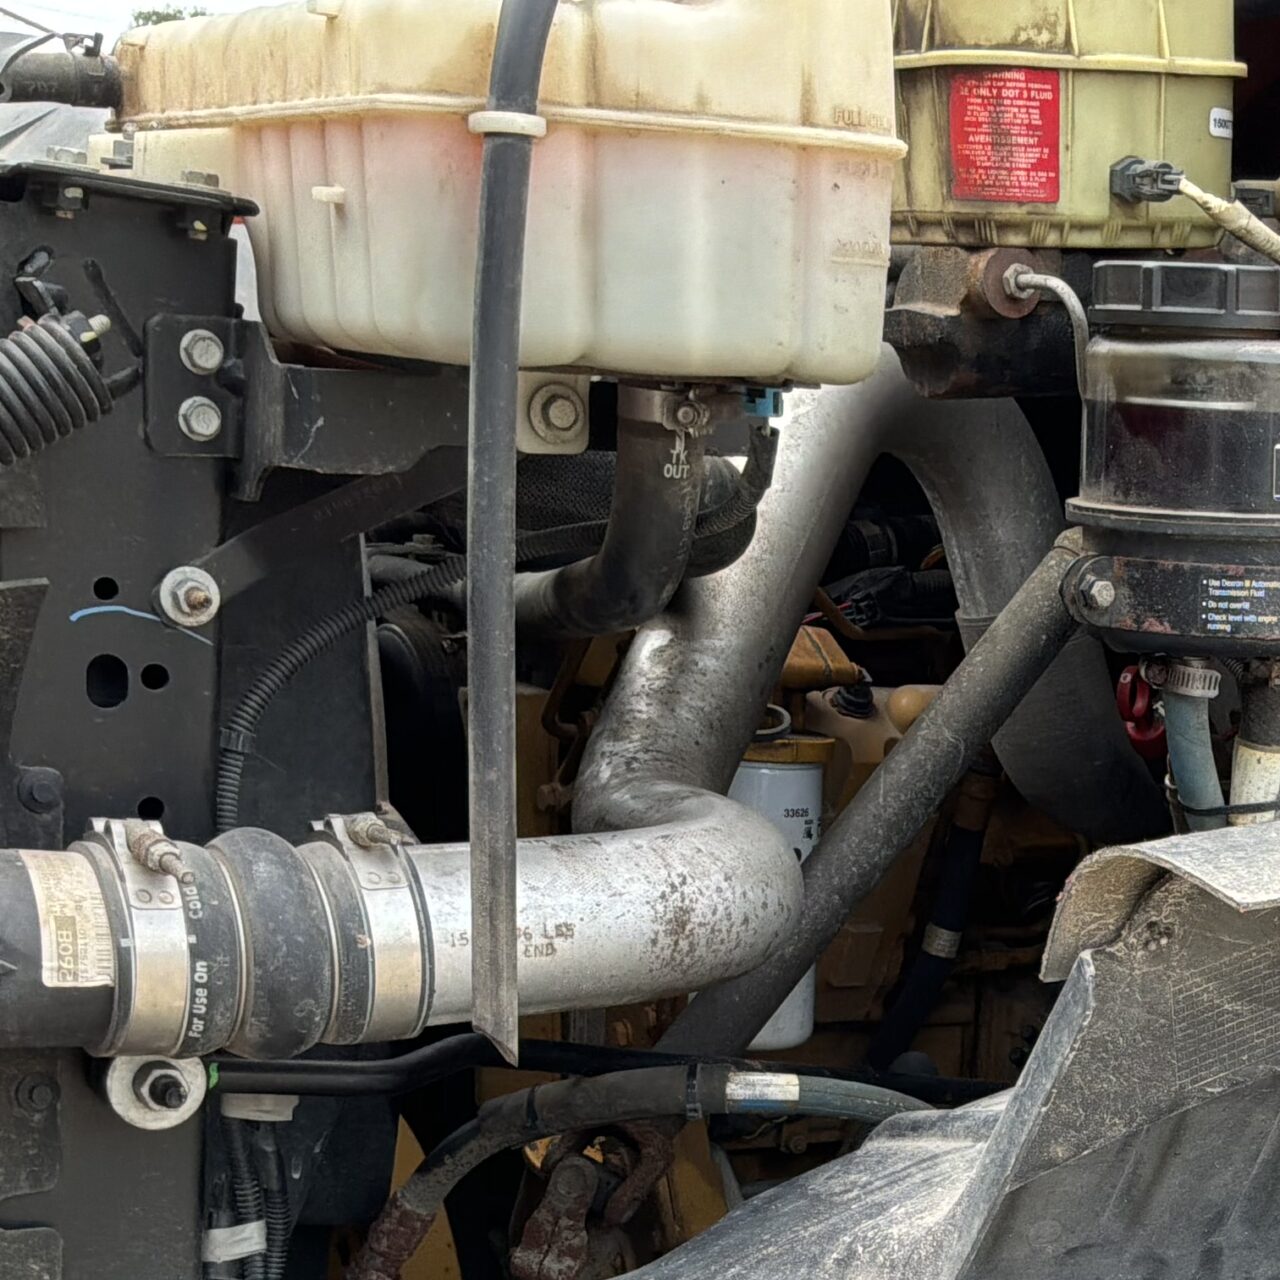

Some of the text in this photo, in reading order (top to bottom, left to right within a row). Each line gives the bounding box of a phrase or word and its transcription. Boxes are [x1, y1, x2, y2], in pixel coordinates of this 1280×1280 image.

[1002, 88, 1020, 97] DOT
[1030, 90, 1053, 100] FLUID
[670, 450, 688, 464] TK
[663, 463, 690, 479] OUT
[1251, 580, 1280, 588] Automatic
[1209, 588, 1265, 597] Transmission Fluid
[1218, 601, 1229, 609] not
[1207, 624, 1231, 632] running
[523, 943, 558, 959] END
[183, 886, 208, 1038] For Use On Cold
